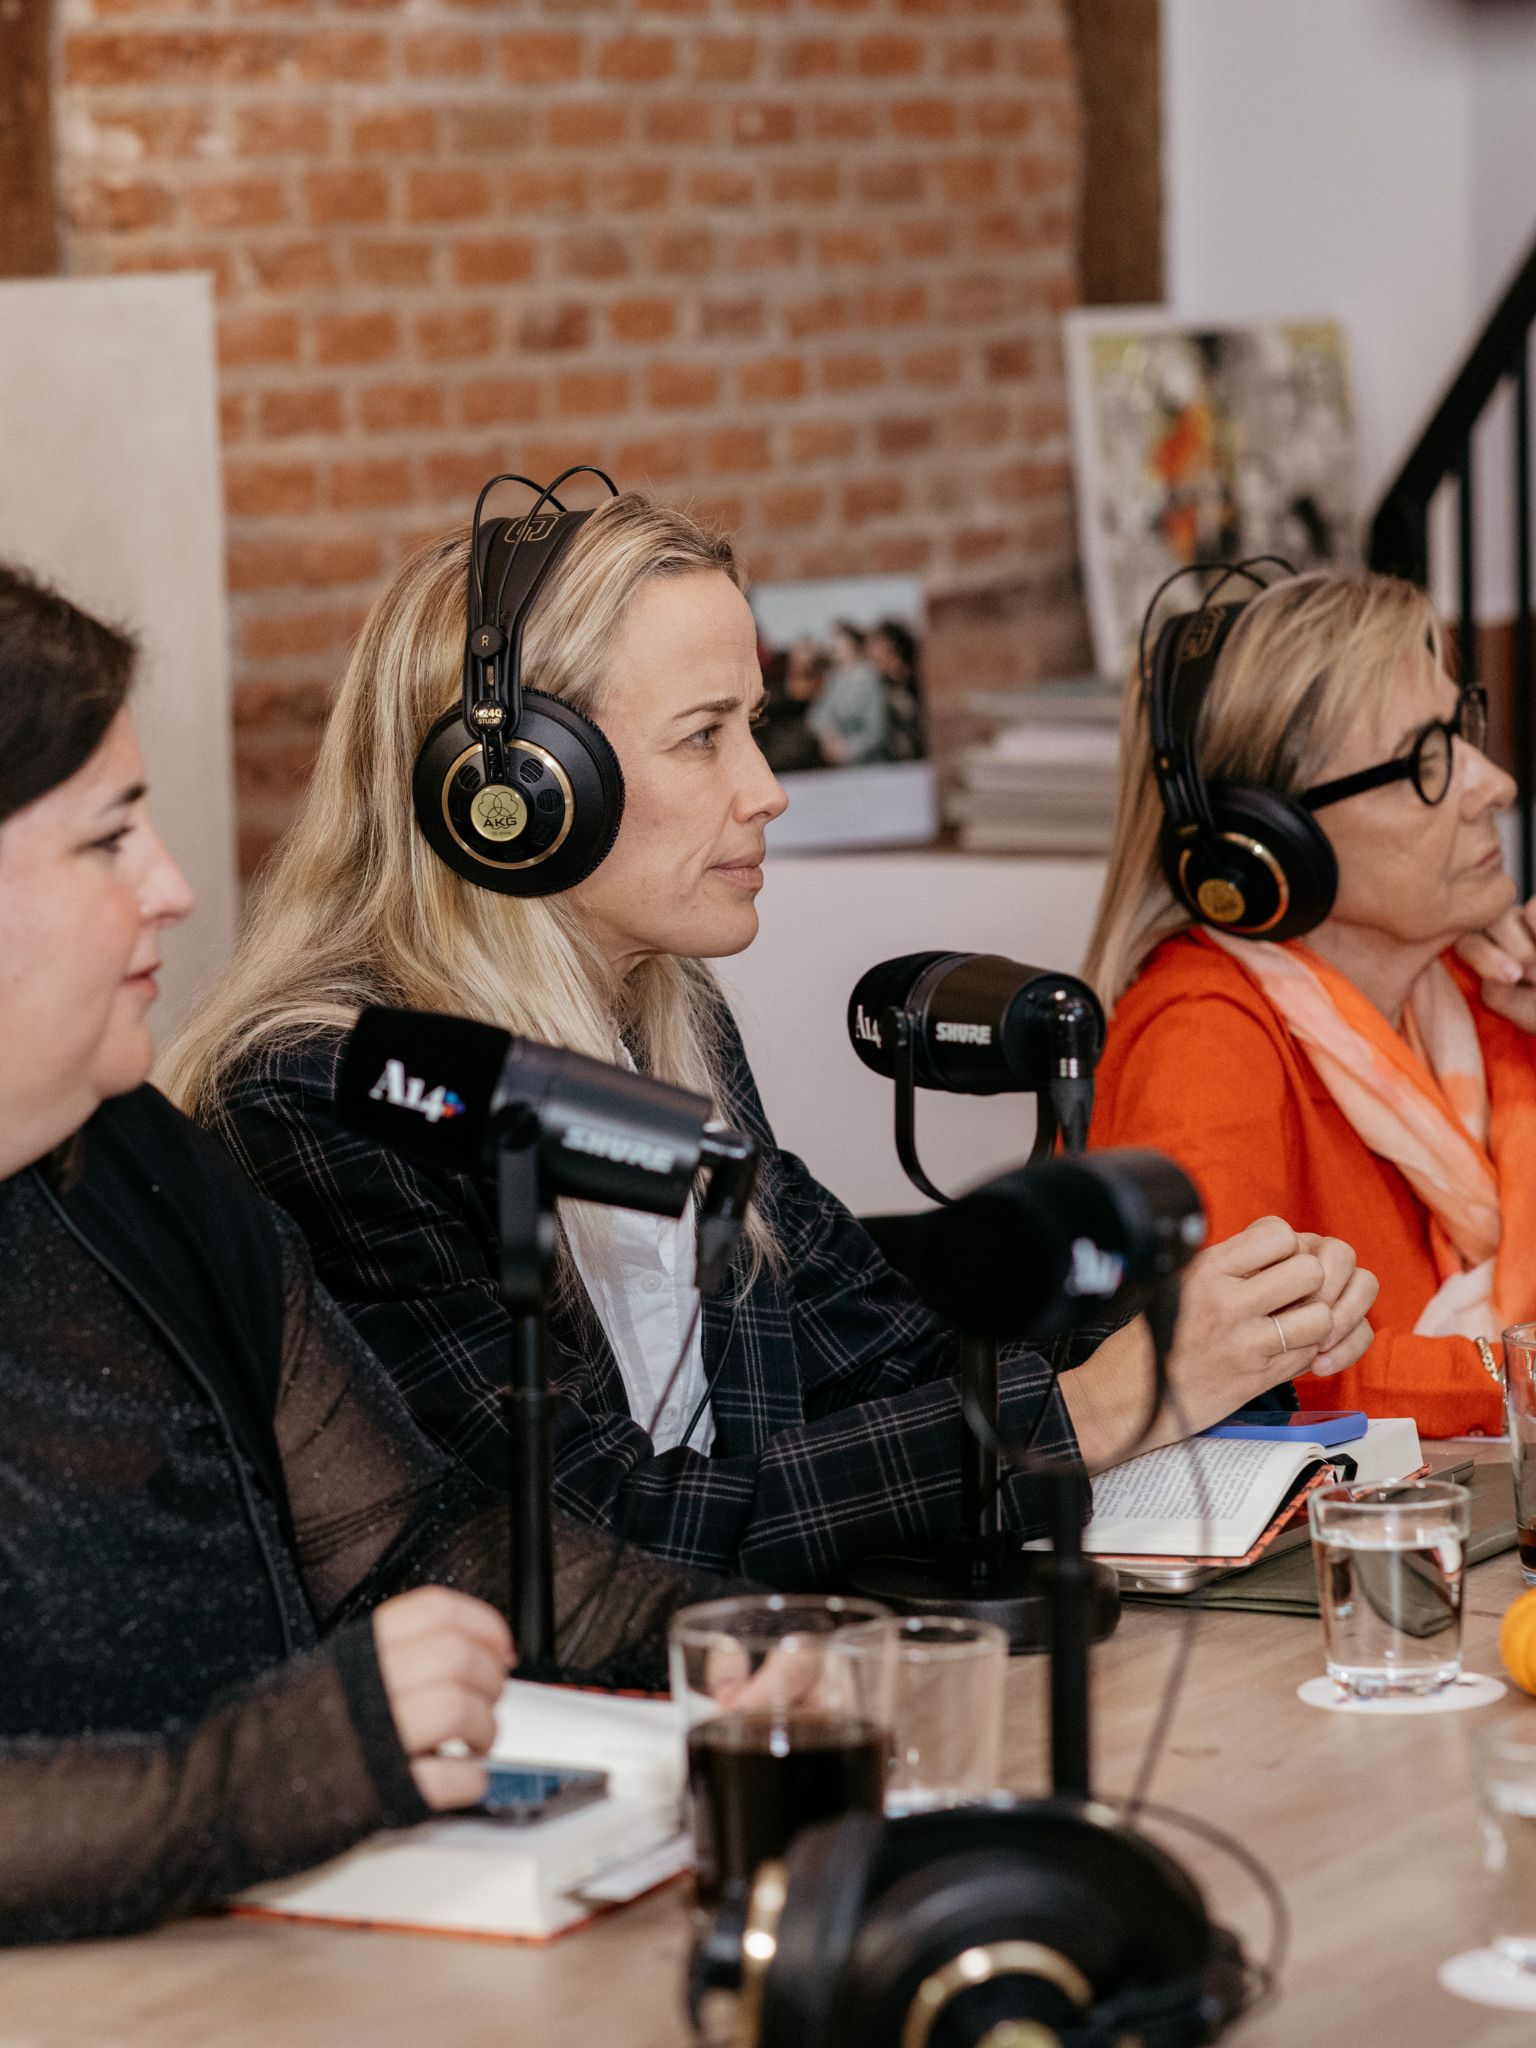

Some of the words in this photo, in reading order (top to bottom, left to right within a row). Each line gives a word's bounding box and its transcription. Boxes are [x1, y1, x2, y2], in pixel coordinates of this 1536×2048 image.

[481, 635, 489, 647] R
[475, 708, 503, 718] K240
[483, 817, 517, 828] AKG
[935, 1021, 992, 1046] SHURE
[561, 1123, 676, 1175] SHURE
